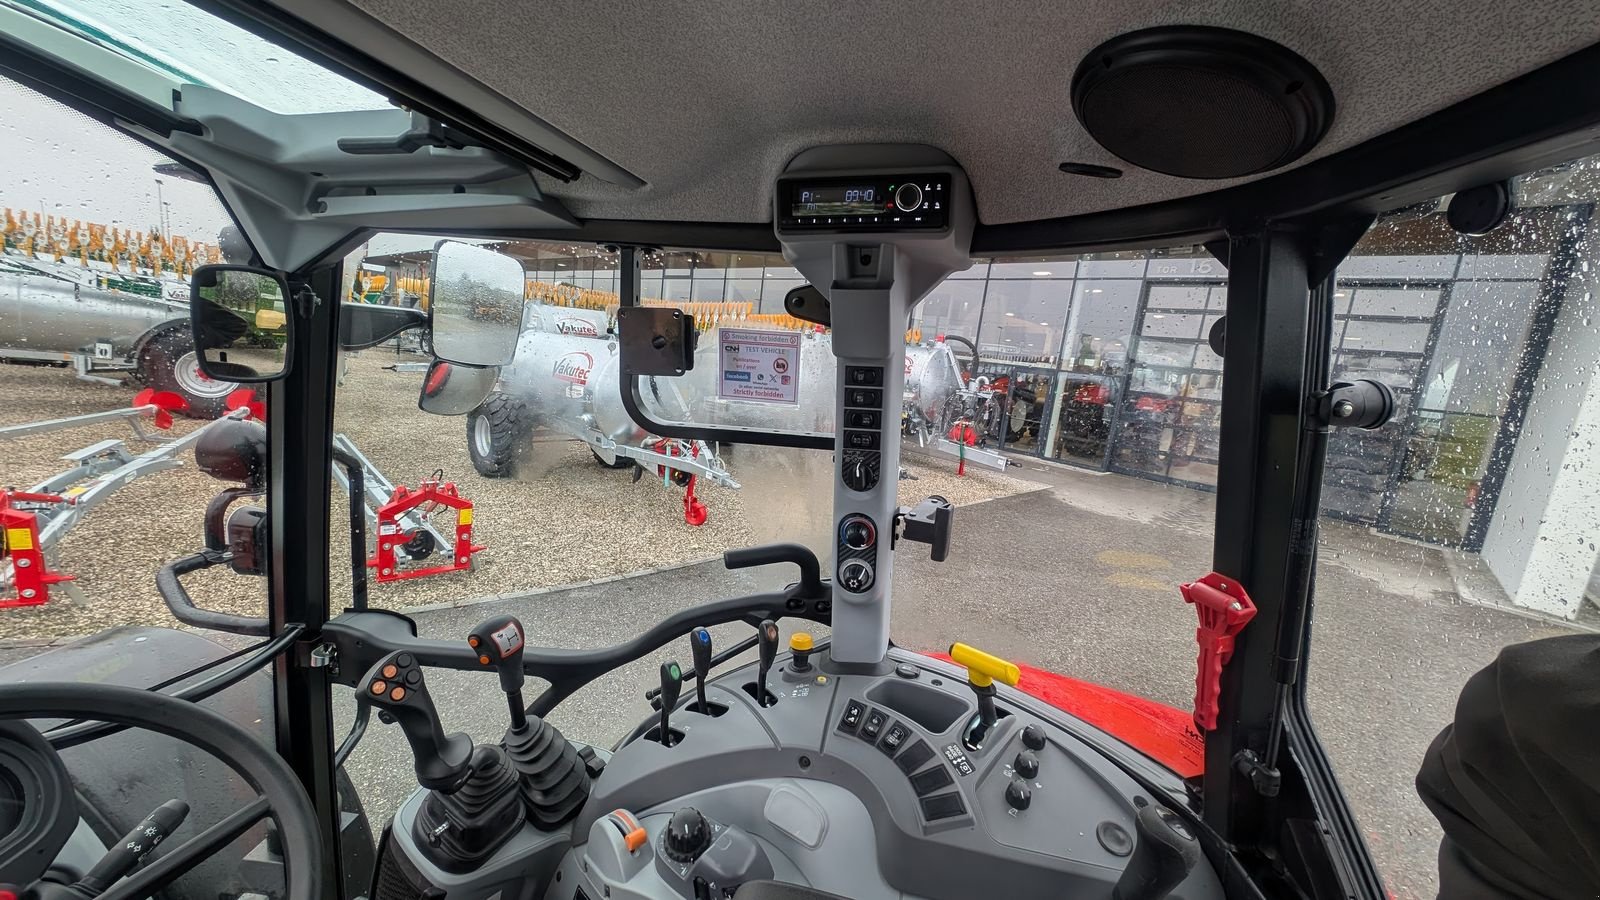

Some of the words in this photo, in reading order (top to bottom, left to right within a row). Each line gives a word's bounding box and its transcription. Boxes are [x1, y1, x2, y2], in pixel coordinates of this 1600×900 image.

[556, 321, 598, 335] Vakutec
[731, 333, 758, 341] Smoking
[759, 335, 789, 343] forbidden
[760, 347, 786, 355] VEHICLE
[552, 358, 591, 380] Vakutec
[733, 388, 754, 397] Strictly
[755, 390, 784, 398] forbidden
